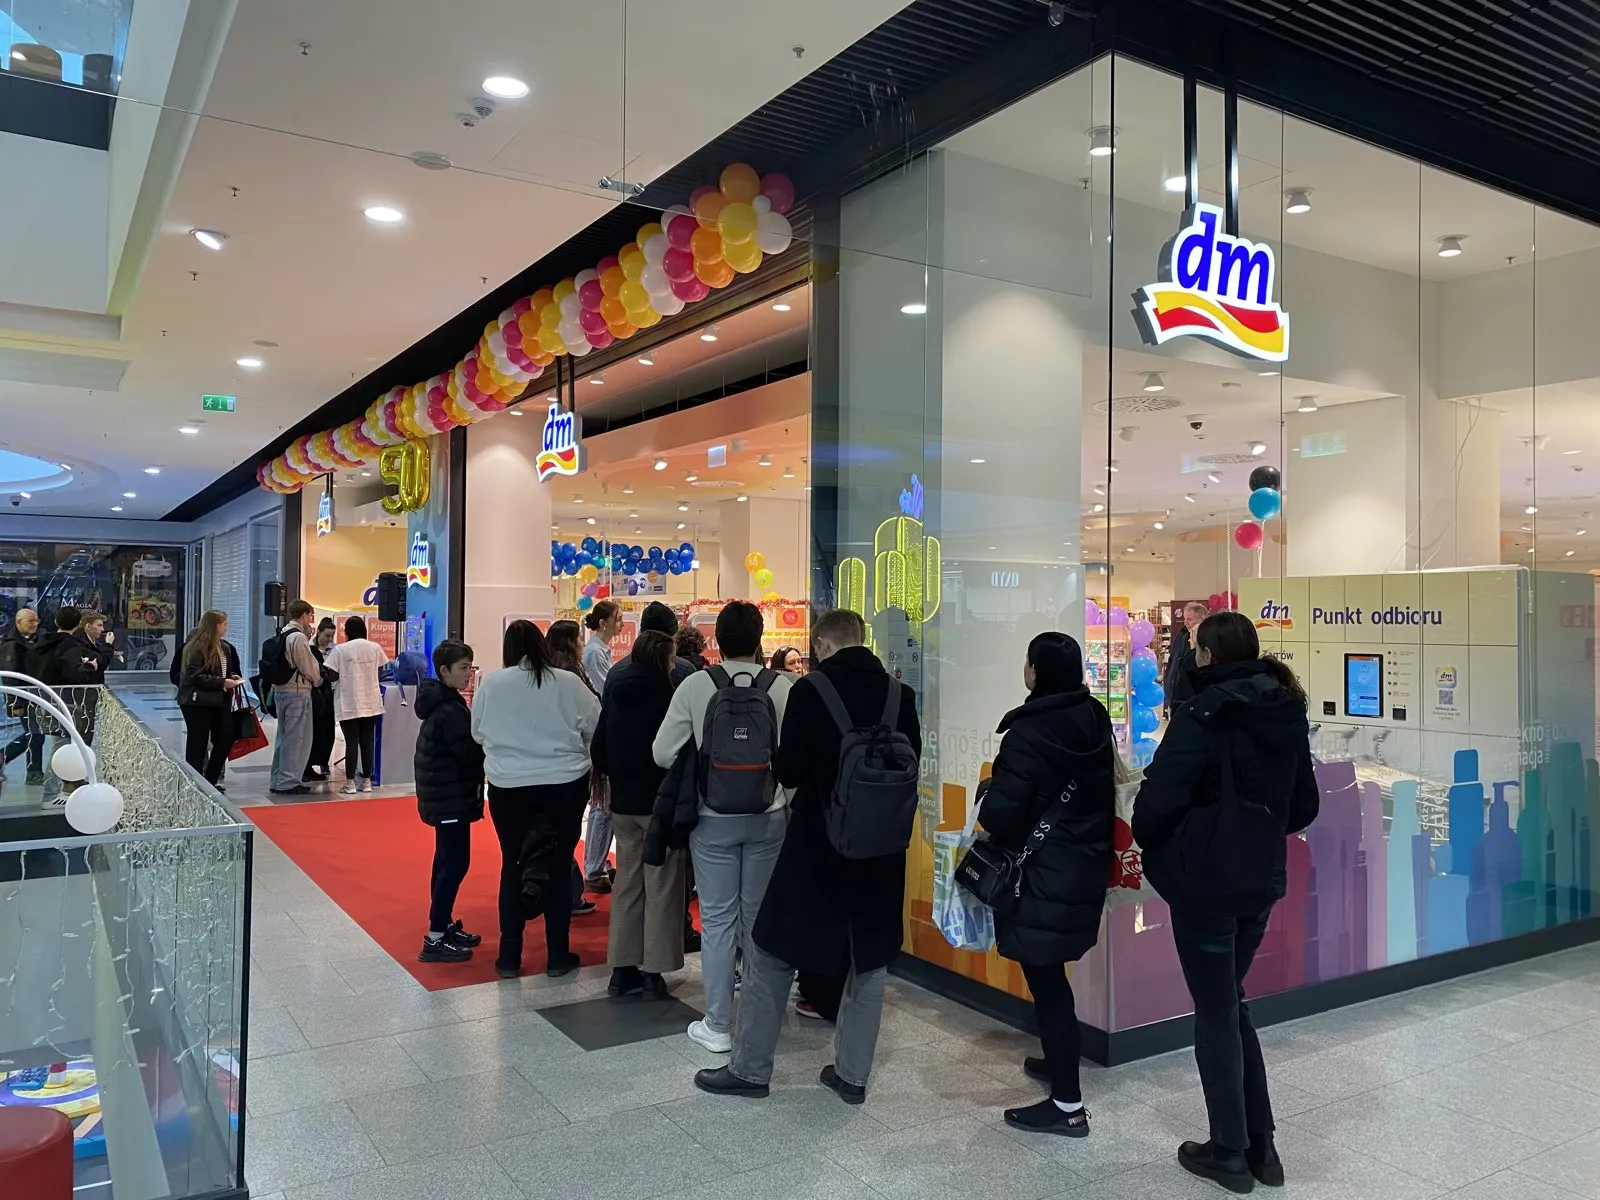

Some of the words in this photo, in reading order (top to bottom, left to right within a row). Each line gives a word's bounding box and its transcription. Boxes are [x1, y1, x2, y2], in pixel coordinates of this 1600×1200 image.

[1177, 211, 1269, 305] dm
[544, 408, 571, 451] dm
[319, 493, 330, 520] dm
[411, 535, 428, 567] dm
[363, 578, 379, 606] d
[1260, 600, 1289, 619] dm
[1312, 607, 1362, 625] Punkt
[1371, 606, 1442, 626] odbioru
[609, 631, 632, 647] puj
